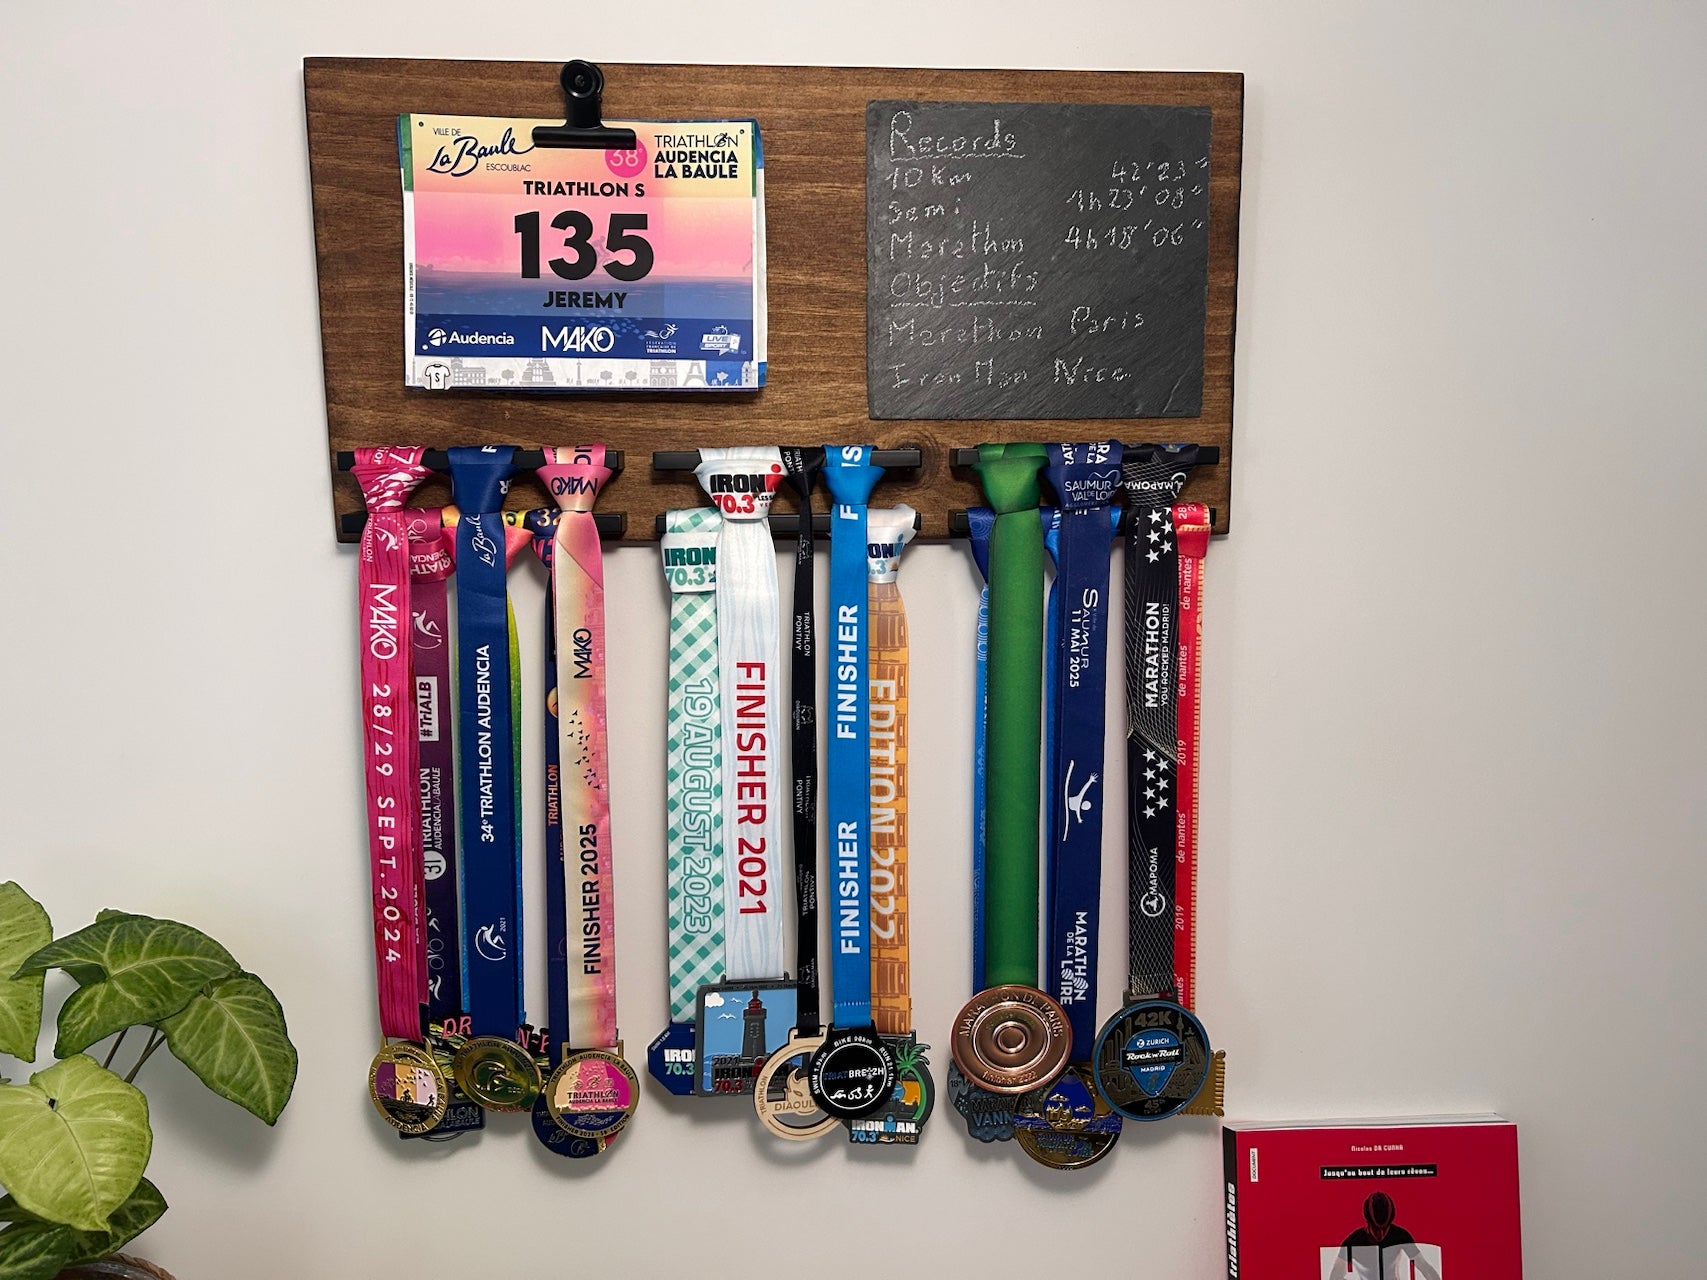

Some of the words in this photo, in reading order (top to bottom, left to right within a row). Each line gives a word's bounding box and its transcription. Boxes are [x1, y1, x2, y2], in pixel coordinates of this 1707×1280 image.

[433, 128, 449, 136] VILLE
[889, 110, 1017, 153] Records
[486, 163, 531, 172] ESCOUBLAC
[654, 151, 738, 164] AUDENCIA
[654, 164, 681, 178] LA
[683, 165, 738, 179] BAULE
[885, 166, 923, 190] 10
[523, 180, 629, 197] TRIATHLON
[634, 183, 645, 197] S
[513, 210, 654, 281] 135
[542, 291, 628, 309] JEREMY
[1070, 305, 1144, 335] Paris
[449, 331, 515, 346] Audencia
[541, 326, 615, 352] MAKO
[435, 372, 440, 382] S
[551, 476, 598, 497] MAKO
[1064, 480, 1112, 492] SAUMUR
[1072, 491, 1088, 502] VAL
[1124, 481, 1173, 490] MAPOMA
[712, 494, 755, 514] 70.3
[665, 567, 706, 586] 70.3
[1071, 608, 1081, 618] 11
[1183, 597, 1190, 610] de
[369, 583, 397, 660] MAKO
[803, 611, 811, 657] TRIATHLON
[1081, 588, 1099, 669] SAUMUR
[572, 628, 592, 679] MAKO
[1070, 628, 1081, 653] MAI
[1145, 602, 1159, 708] MARATHON
[1161, 645, 1169, 686] ROCKED
[837, 604, 858, 739] FINISHER
[1069, 656, 1080, 688] 2025
[476, 644, 492, 729] AUDENCIA
[683, 678, 714, 718] 19
[1161, 687, 1169, 706] YOU
[1178, 684, 1186, 697] de
[736, 662, 767, 825] FINISHER
[869, 679, 895, 834] EDITION
[1177, 740, 1186, 766] 2019
[479, 732, 494, 818] TRIATHLON
[682, 723, 714, 852] AUGUST
[547, 764, 558, 826] TRIATHLON
[579, 823, 599, 876] 2025
[1176, 849, 1186, 863] de
[738, 837, 767, 915] 2021
[1149, 847, 1158, 895] MAPOMA
[682, 856, 713, 934] 2023
[802, 870, 810, 916] TRIATHLON
[838, 821, 861, 954] FINISHER
[870, 847, 895, 939] 2022
[581, 879, 602, 975] FINISHER
[1175, 905, 1185, 931] 2019
[1066, 931, 1074, 944] DE
[1066, 945, 1074, 957] LA
[1074, 911, 1089, 1001] MARATHON
[1134, 1011, 1172, 1027] 42K
[1146, 1038, 1169, 1046] ZURICH
[551, 1056, 577, 1083] TRIATHLON
[580, 1052, 611, 1060] AUDENCIA
[665, 1062, 695, 1075] 70.3
[812, 1077, 820, 1094] SWIM
[834, 1036, 851, 1047] BIKE
[879, 1047, 889, 1062] RUN
[1140, 1065, 1165, 1073] MADRID
[760, 1075, 768, 1115] TRIATHLON
[852, 1131, 877, 1142] 70.3
[895, 1135, 916, 1143] NICE
[1376, 1168, 1385, 1176] de
